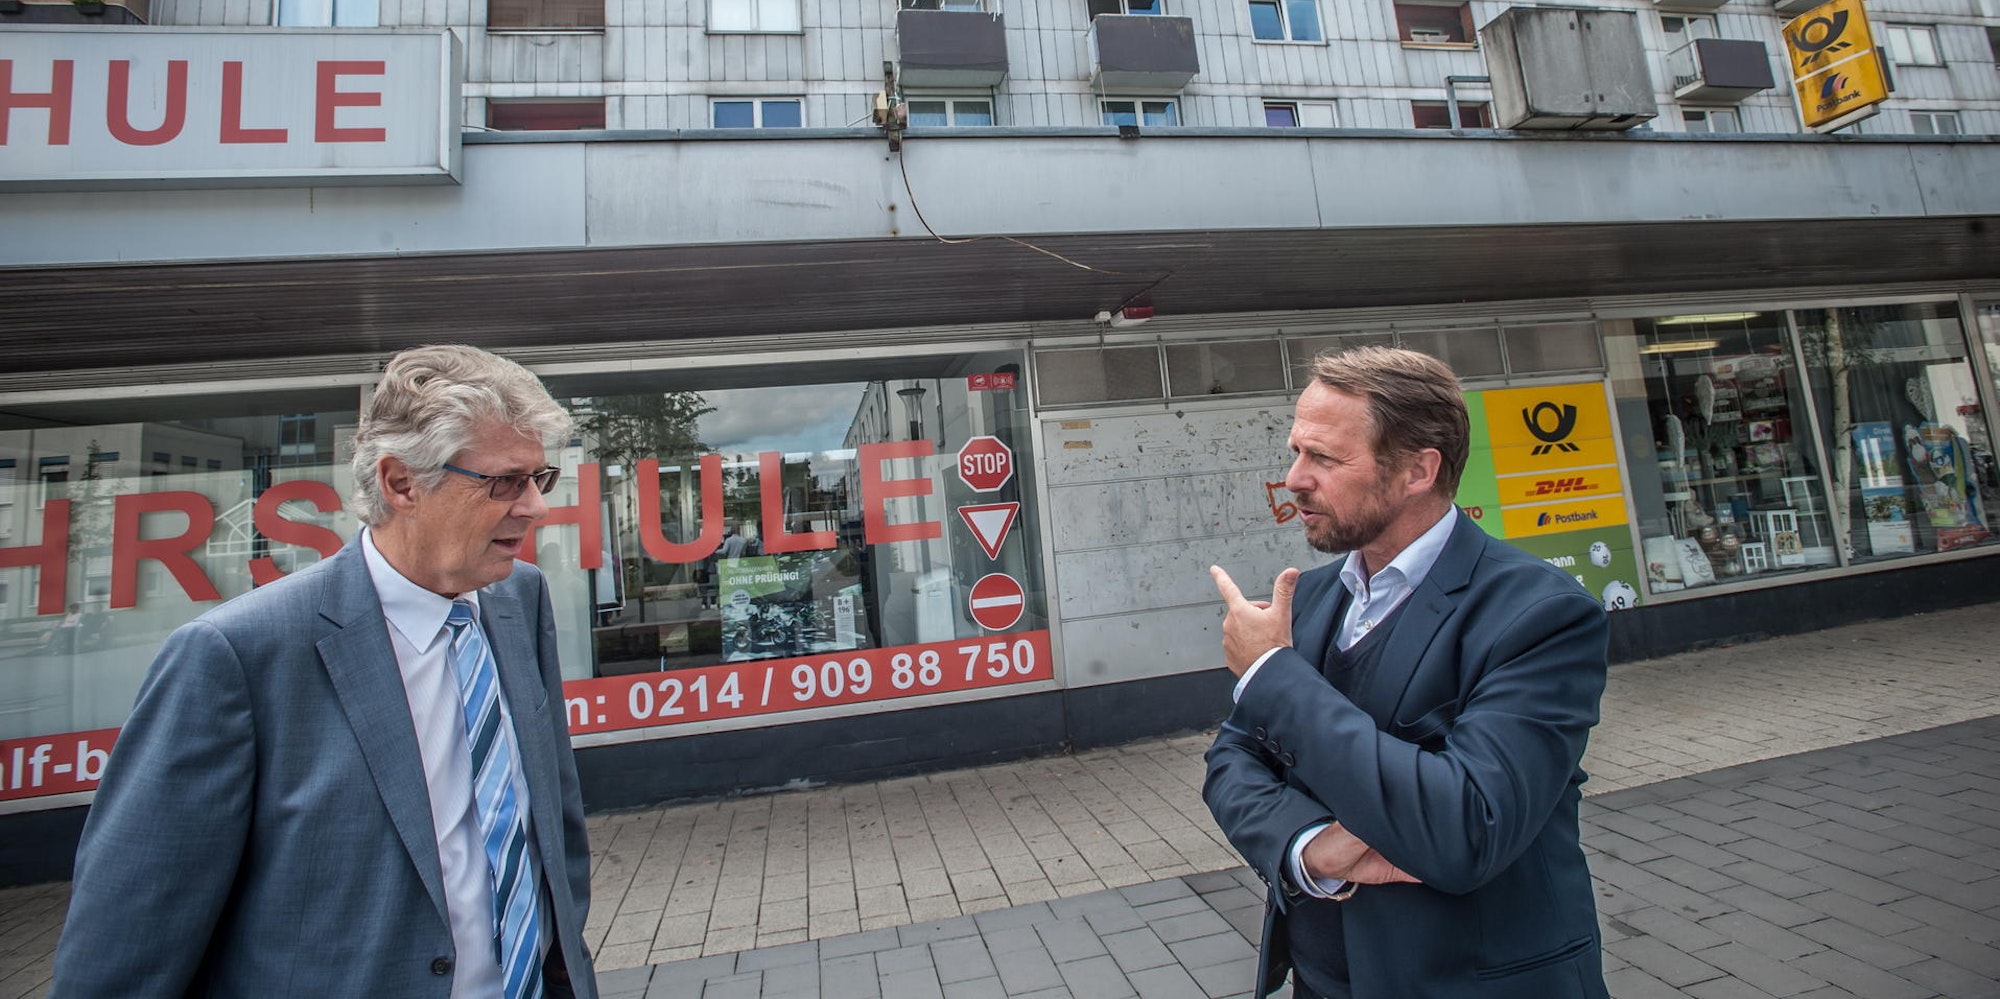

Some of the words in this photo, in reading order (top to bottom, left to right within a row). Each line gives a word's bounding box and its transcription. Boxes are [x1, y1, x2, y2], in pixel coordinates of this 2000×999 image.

[0, 59, 386, 146] HULE
[1816, 90, 1861, 112] Postbank
[963, 452, 1007, 476] STOP
[1535, 477, 1588, 495] DHL
[1555, 509, 1598, 525] Postbank
[729, 574, 754, 586] OHNE
[755, 571, 799, 584] PRÜFUNG!
[628, 671, 744, 720] 0214
[761, 667, 774, 706] /
[791, 658, 873, 701] 909
[891, 650, 942, 690] 88
[958, 639, 1036, 681] 750
[0, 740, 109, 791] lf-b
